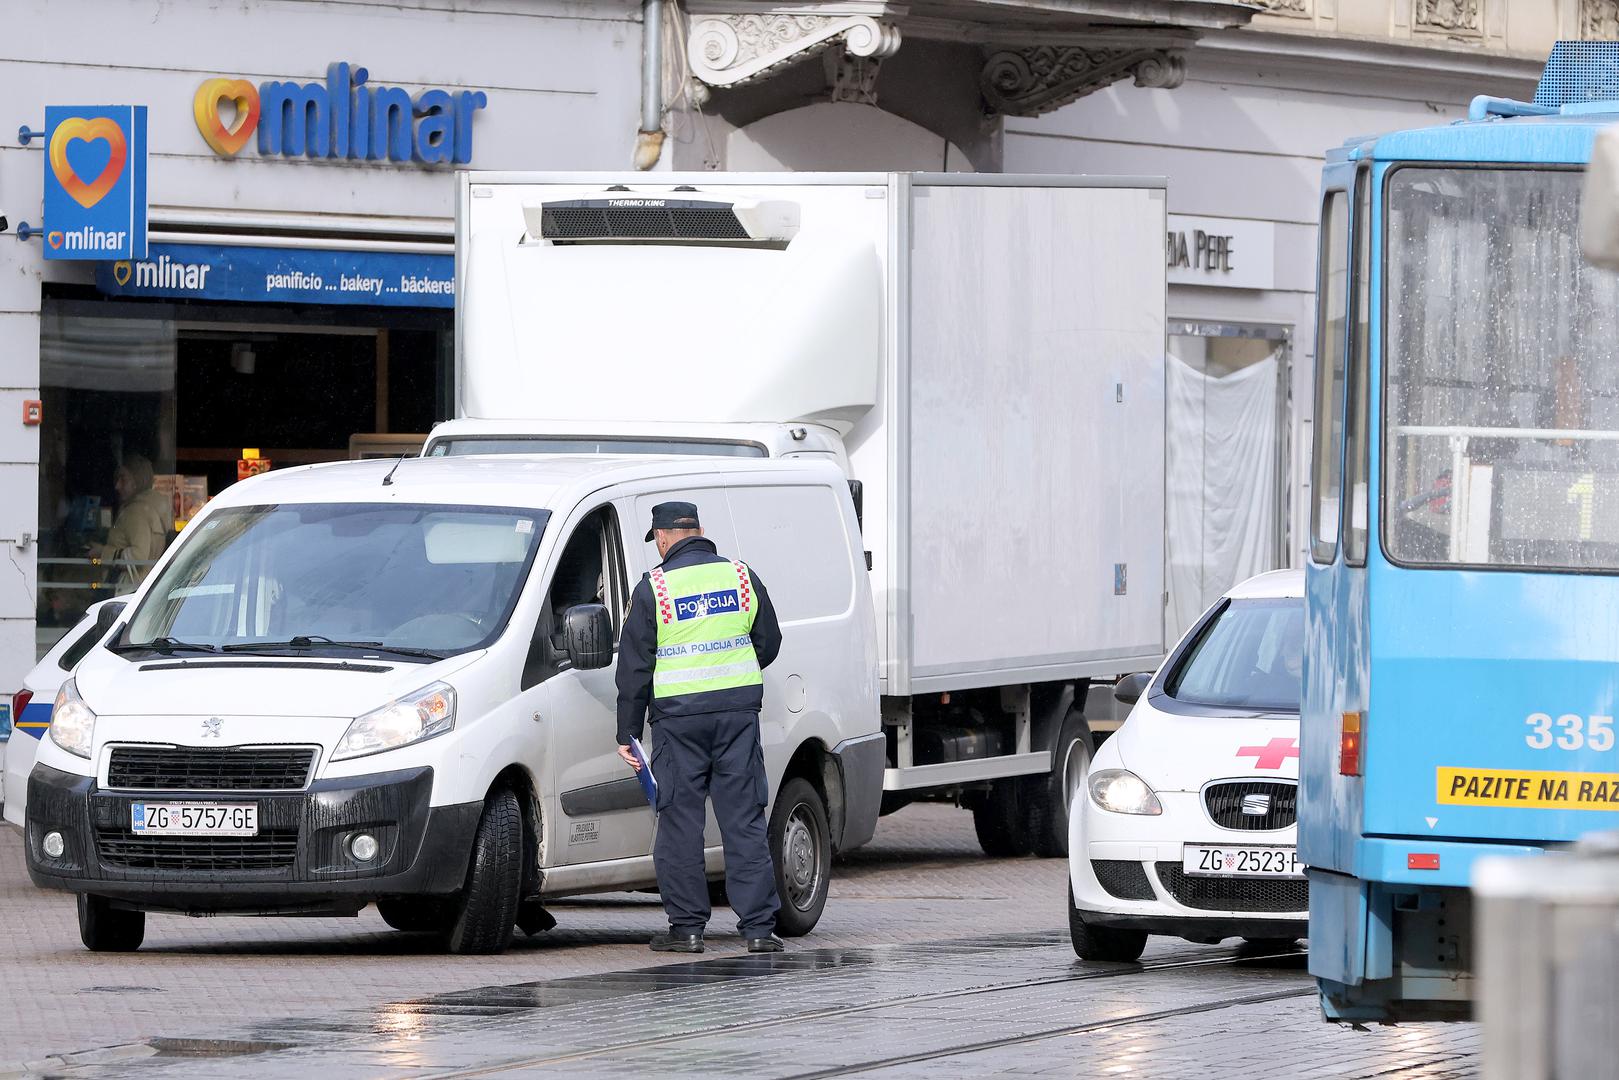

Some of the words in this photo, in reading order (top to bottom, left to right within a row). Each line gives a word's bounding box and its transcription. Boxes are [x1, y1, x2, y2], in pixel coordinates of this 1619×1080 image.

[257, 61, 487, 164] mlinar
[608, 199, 644, 207] THERMO
[644, 199, 665, 207] KING
[65, 225, 126, 250] mlinar
[136, 255, 211, 290] mlinar
[266, 271, 323, 292] panificio
[340, 274, 383, 296] bakery
[401, 275, 455, 295] bäckerei
[691, 640, 733, 653] POLICIJA
[1525, 712, 1615, 752] 335
[1450, 775, 1531, 800] PAZITE
[1537, 779, 1568, 801] NA
[1577, 781, 1619, 803] RAZ
[146, 807, 169, 828] ZG
[1199, 849, 1223, 871] ZG
